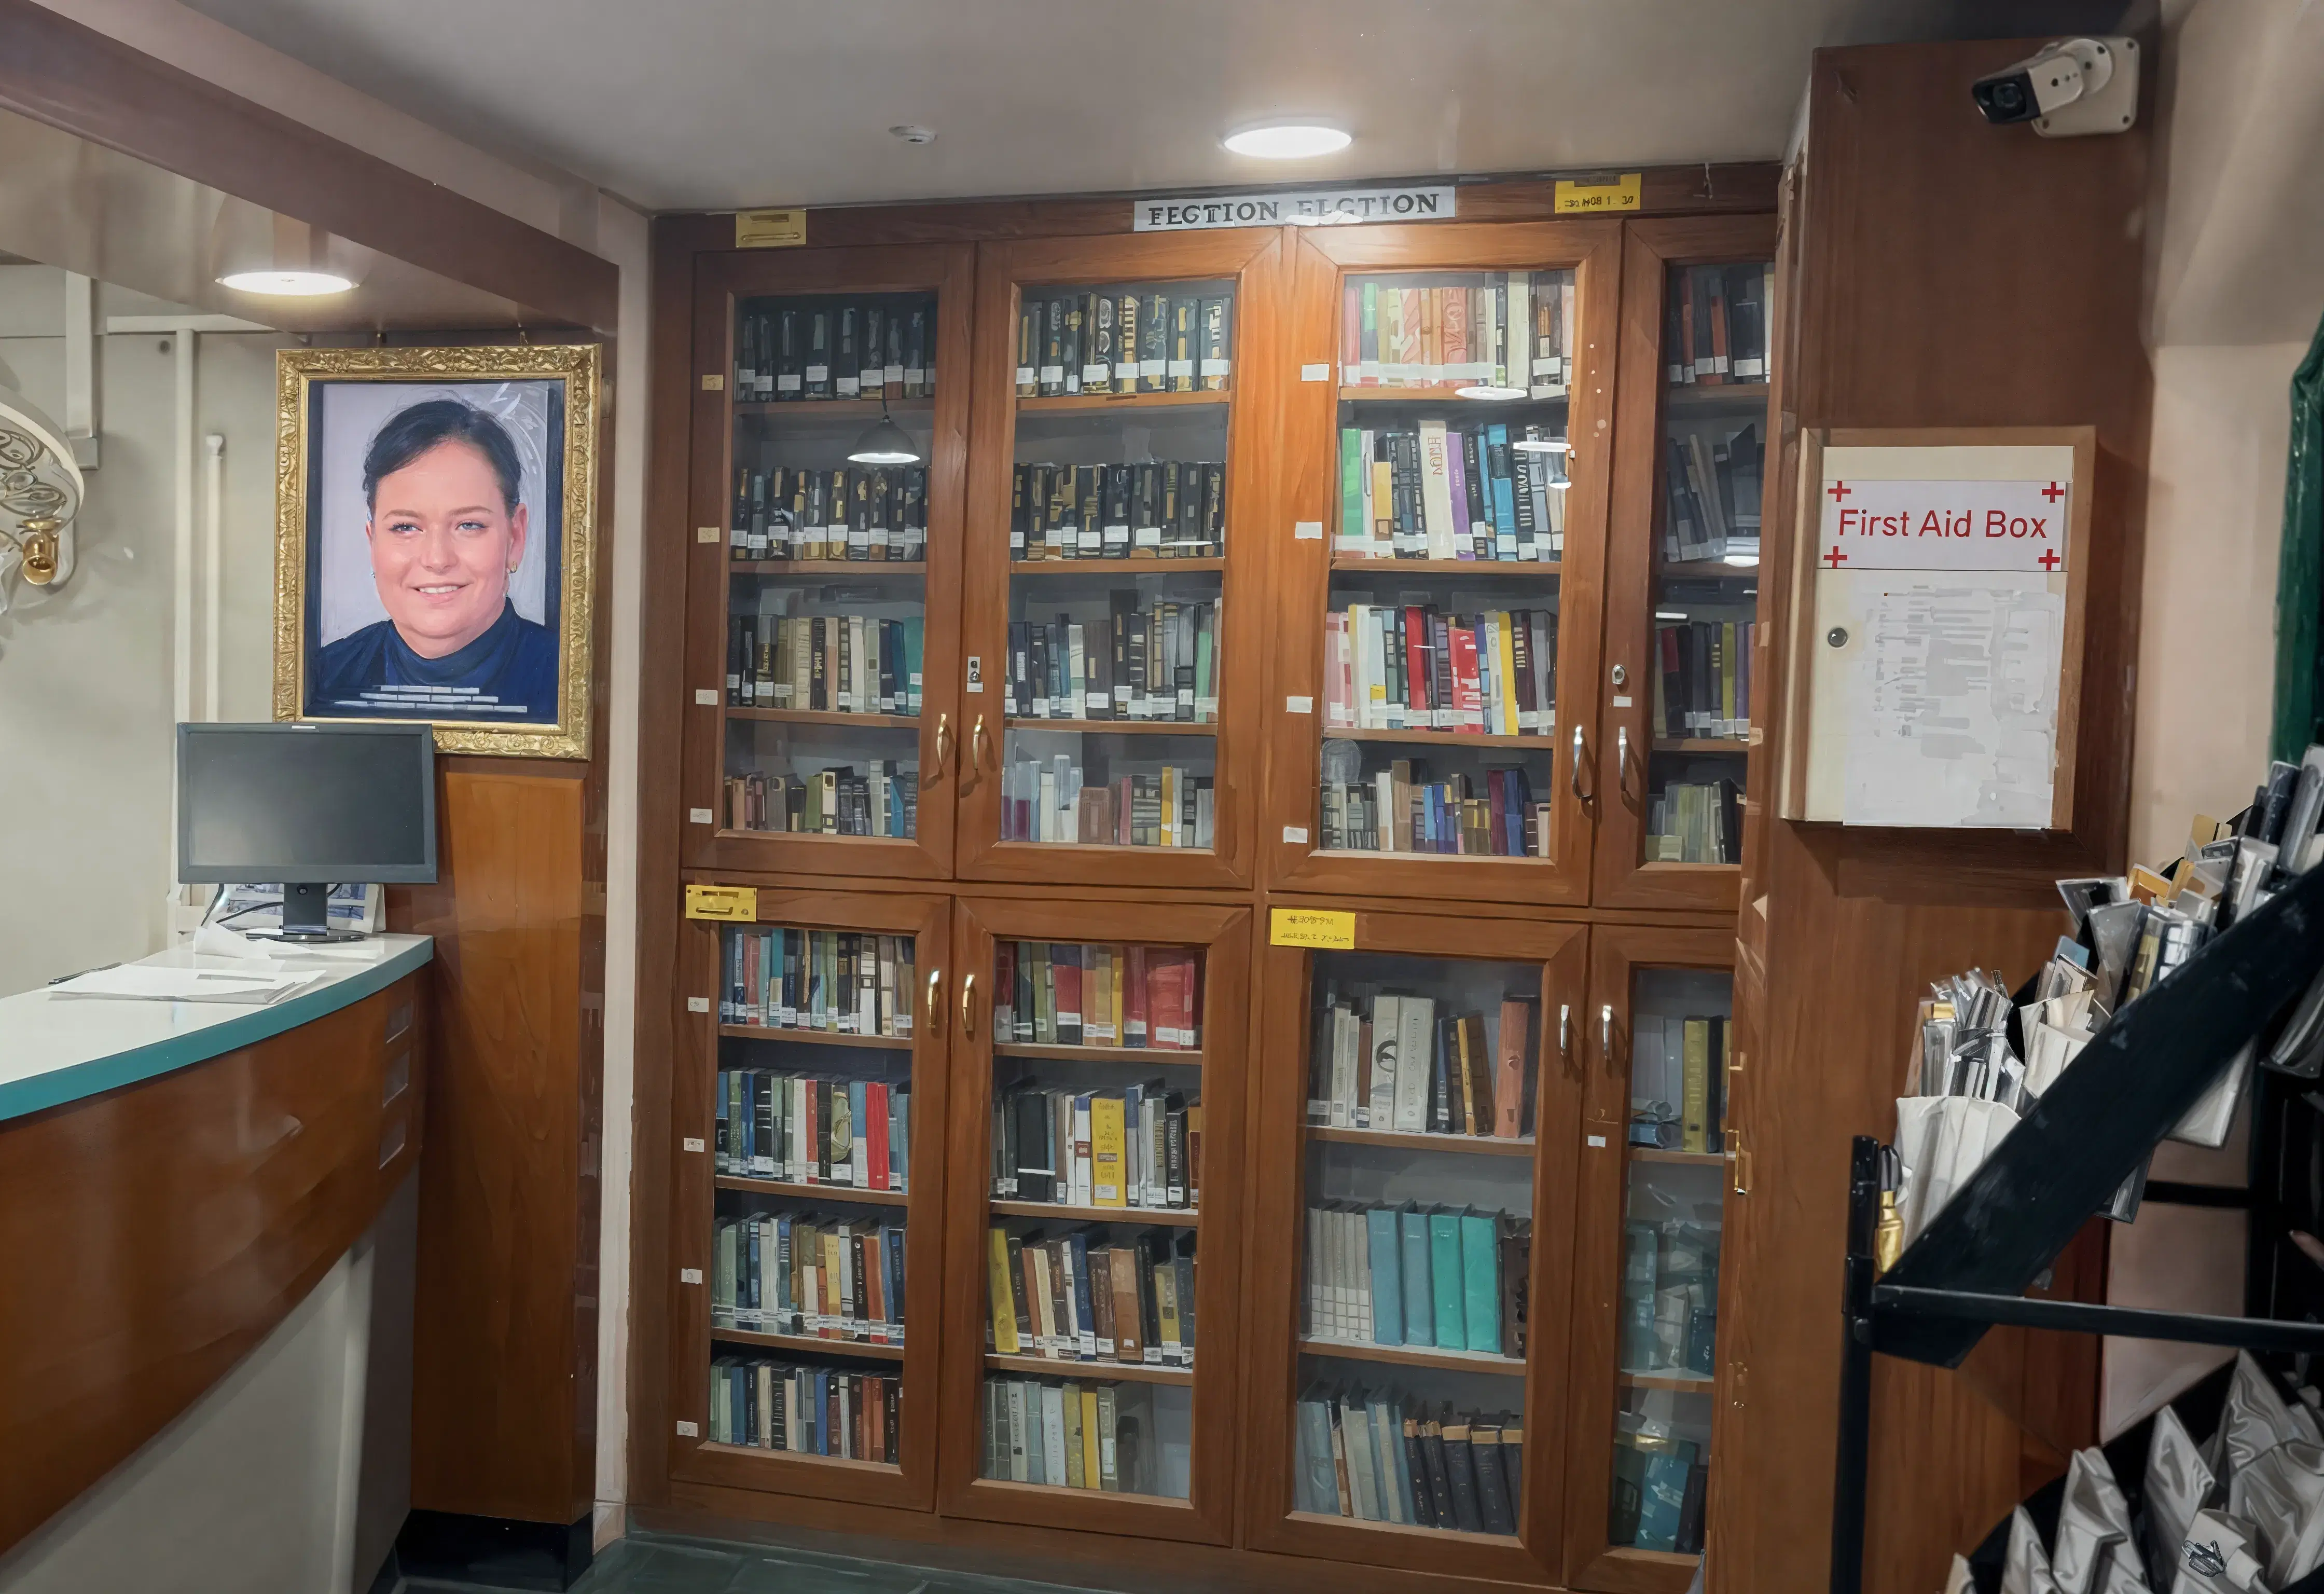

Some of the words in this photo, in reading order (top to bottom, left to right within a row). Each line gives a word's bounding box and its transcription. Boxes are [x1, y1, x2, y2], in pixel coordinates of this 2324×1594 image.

[1838, 509, 1910, 536] First
[1918, 510, 1972, 538] Aid
[1985, 510, 2048, 539] Box
